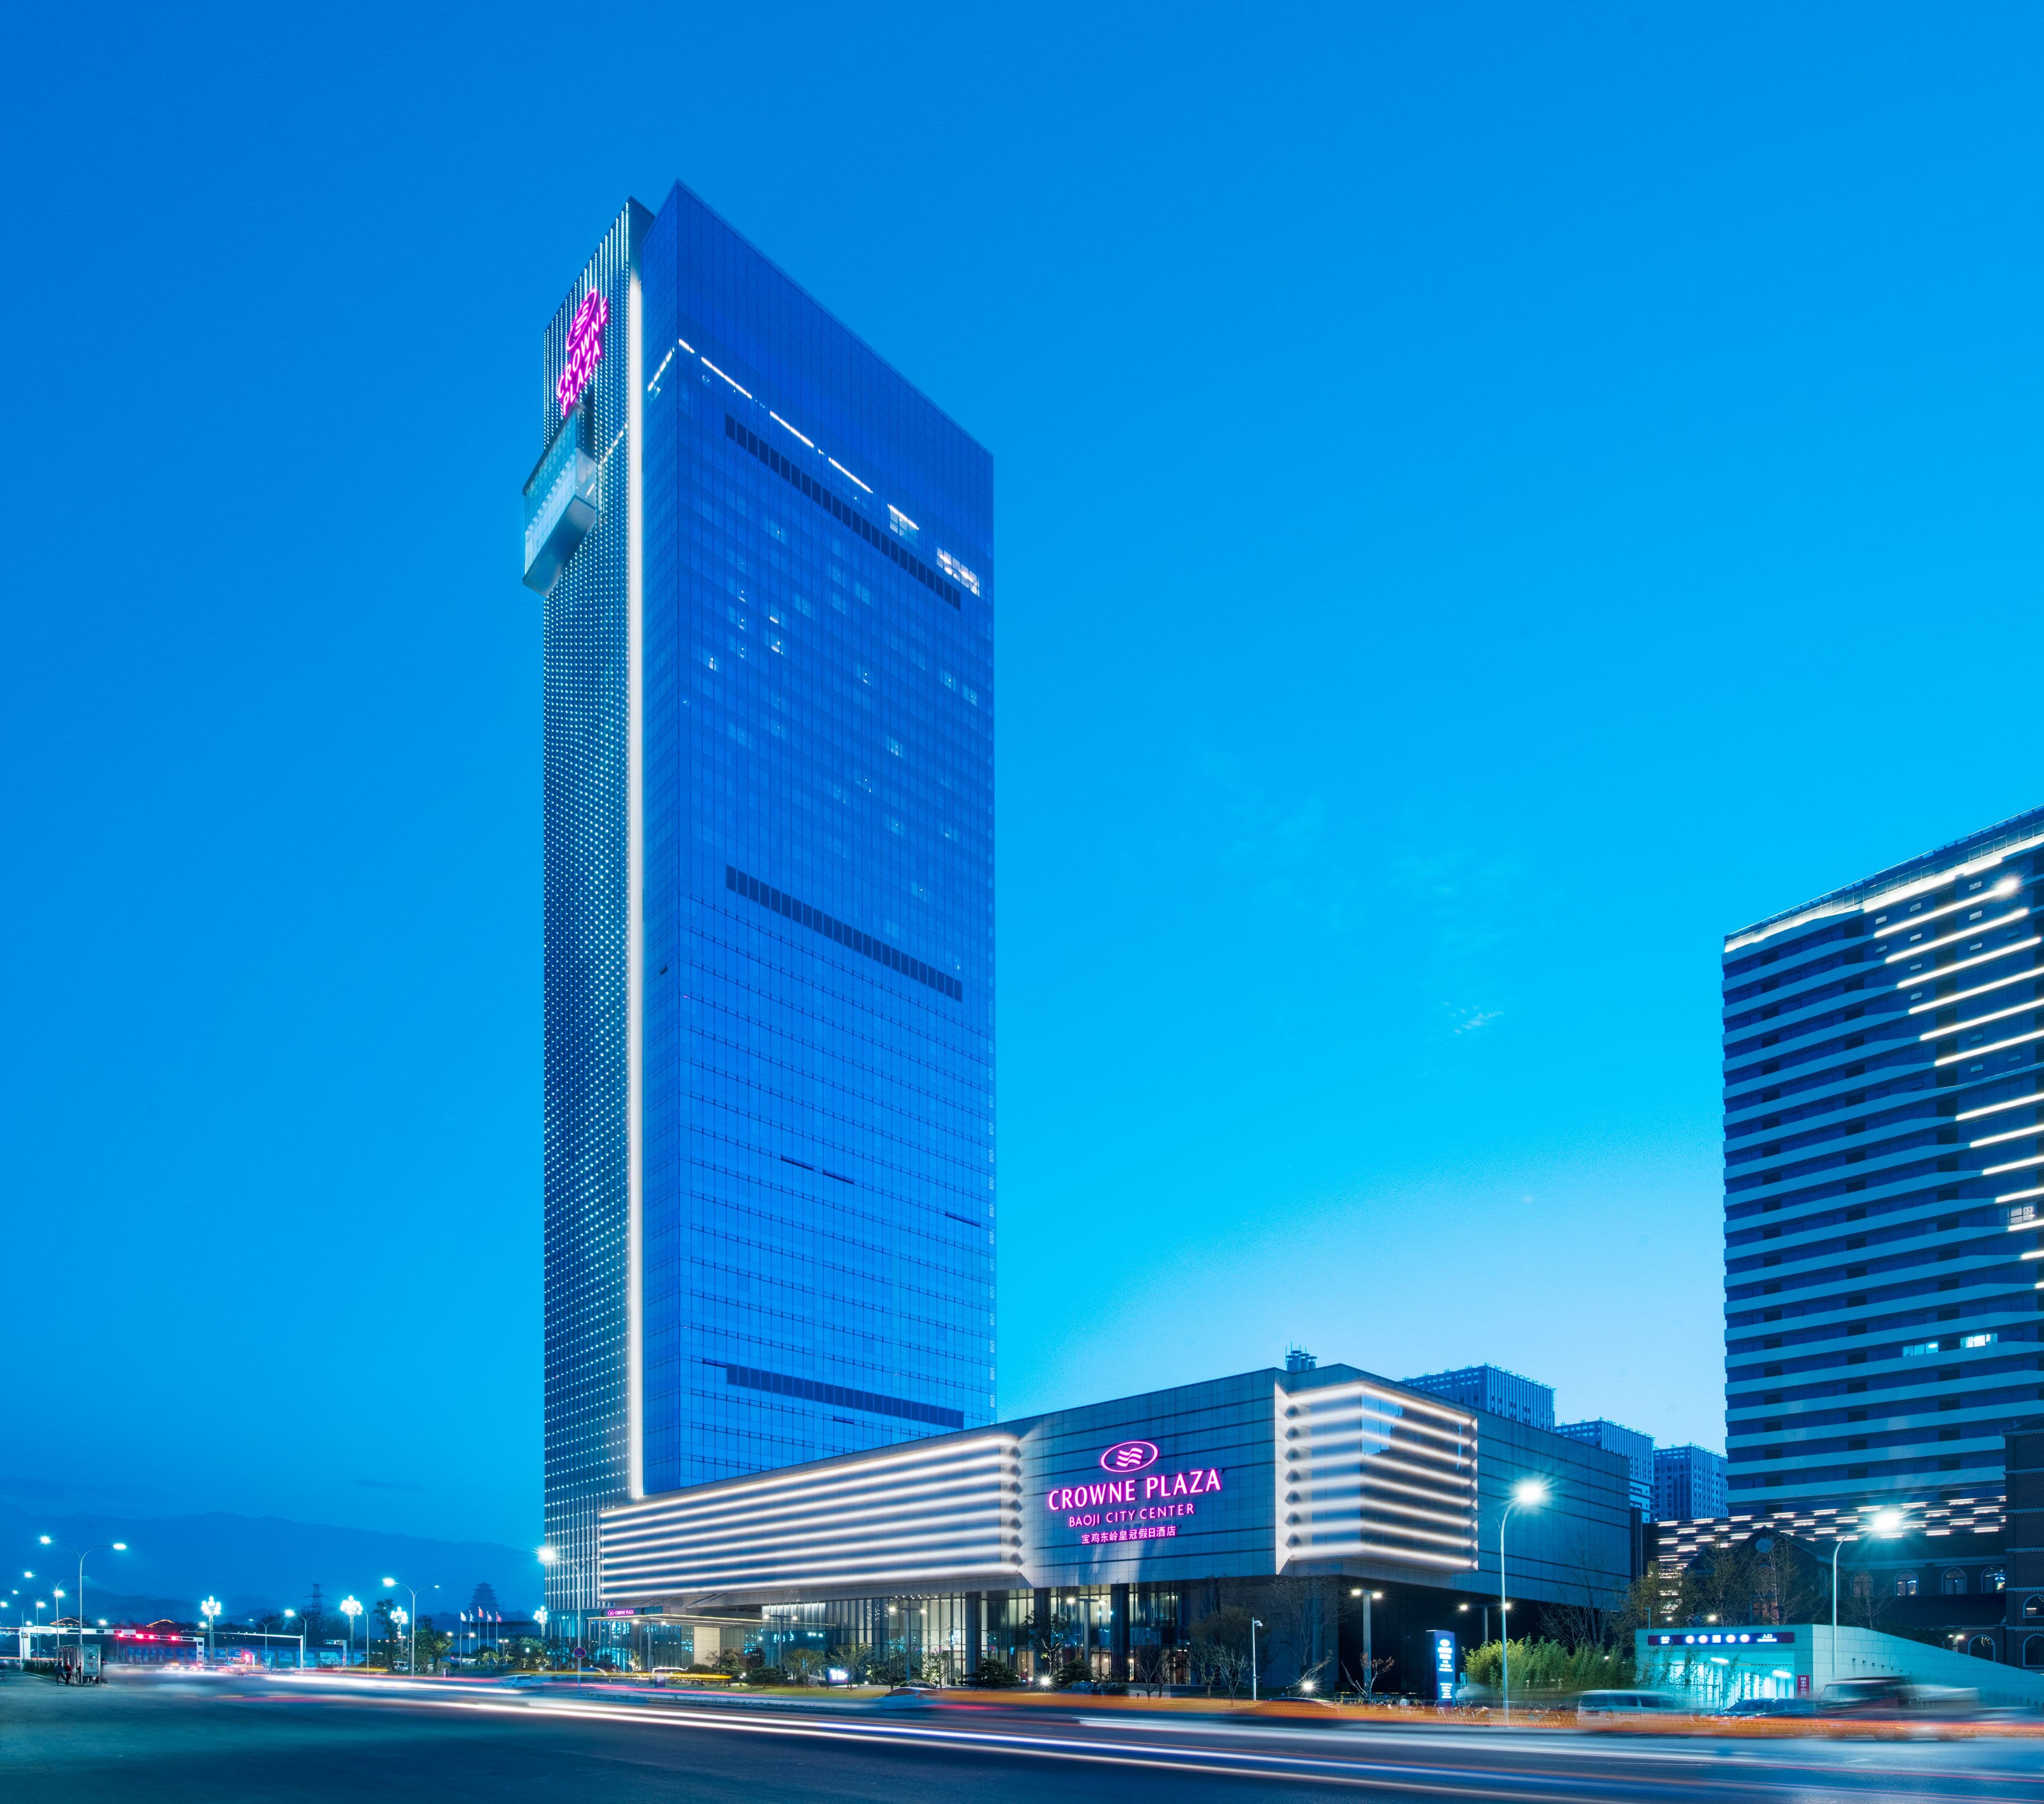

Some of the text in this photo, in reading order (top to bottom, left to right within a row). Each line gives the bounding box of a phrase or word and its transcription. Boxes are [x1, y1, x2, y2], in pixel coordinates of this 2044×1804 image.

[558, 297, 607, 398] CROWNE
[563, 340, 600, 416] PLAZA
[1048, 1469, 1221, 1511] CROWNE PLAZA
[1069, 1503, 1194, 1527] BAOJI CITY CENTER
[1082, 1526, 1176, 1544] 宝鸡东岭皇冠假日酒店
